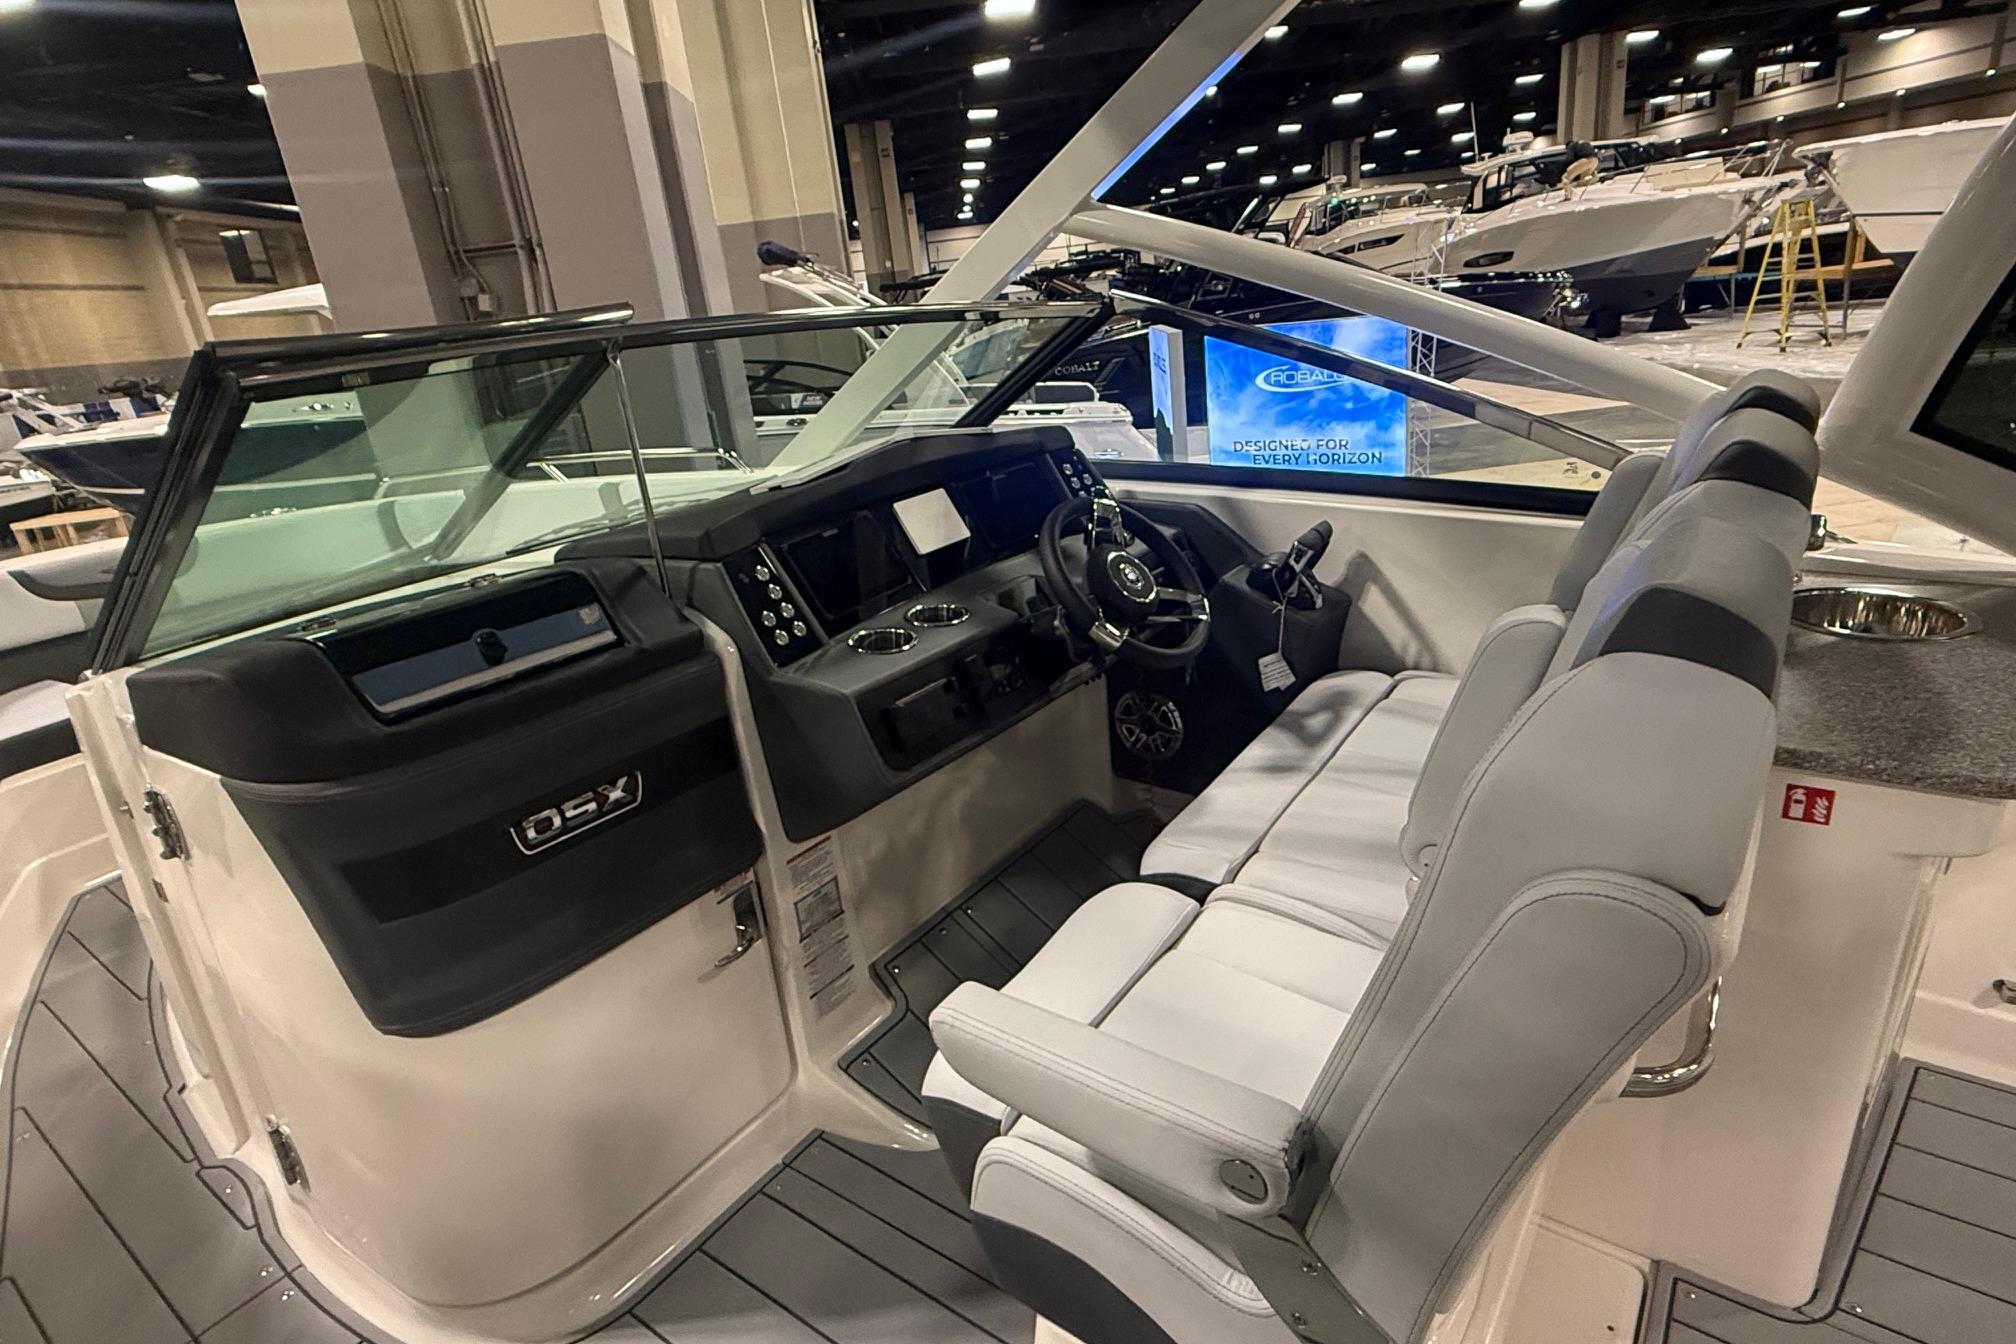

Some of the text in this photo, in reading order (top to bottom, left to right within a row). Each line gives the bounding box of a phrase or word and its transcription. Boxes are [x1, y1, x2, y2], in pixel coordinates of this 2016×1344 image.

[1054, 360, 1100, 376] COBALT
[1233, 438, 1349, 453] DESIGNED FOR
[1252, 451, 1382, 465] EVERY HORIZON
